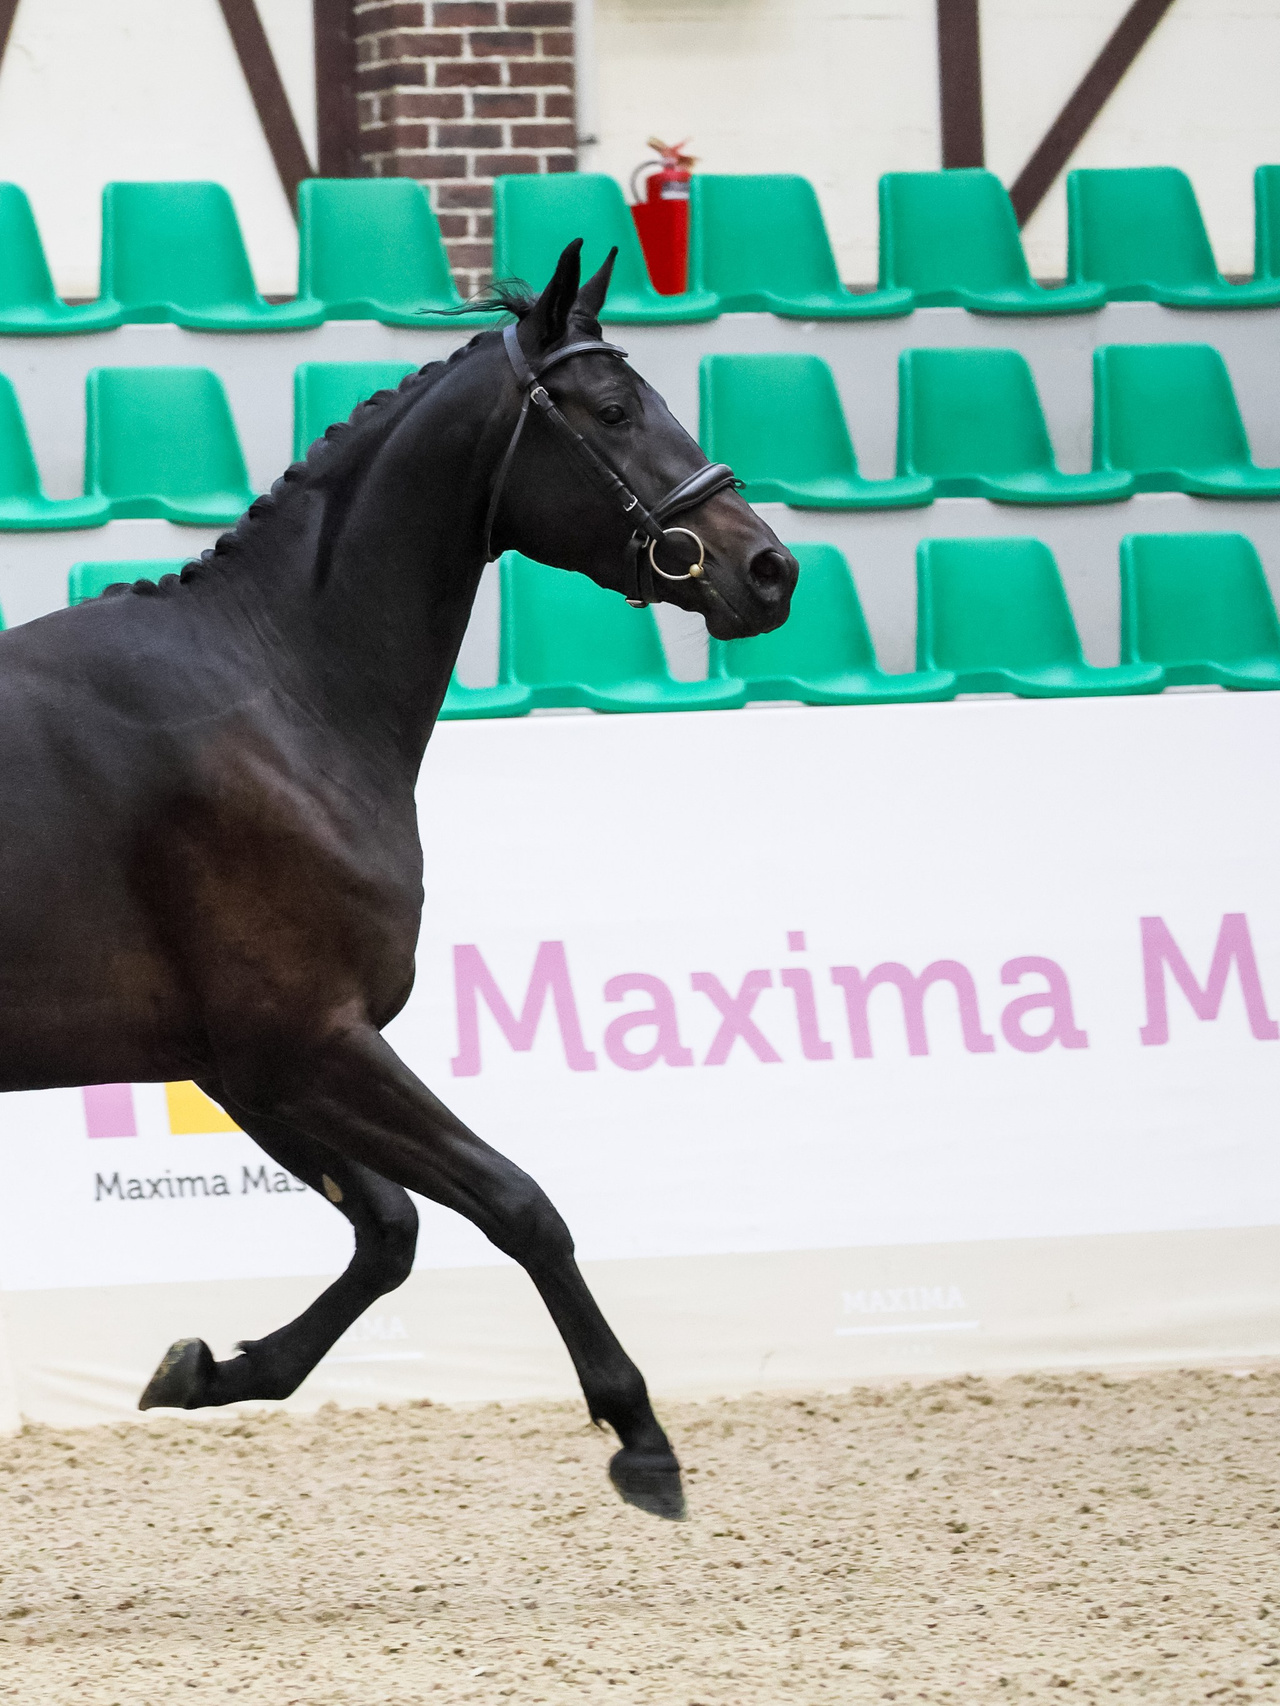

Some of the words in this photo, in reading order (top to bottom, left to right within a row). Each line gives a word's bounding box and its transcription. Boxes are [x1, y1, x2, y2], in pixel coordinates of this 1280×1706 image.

[451, 930, 1088, 1077] Maxima
[95, 1168, 231, 1202] Maxima
[841, 1282, 969, 1316] MAXIMA
